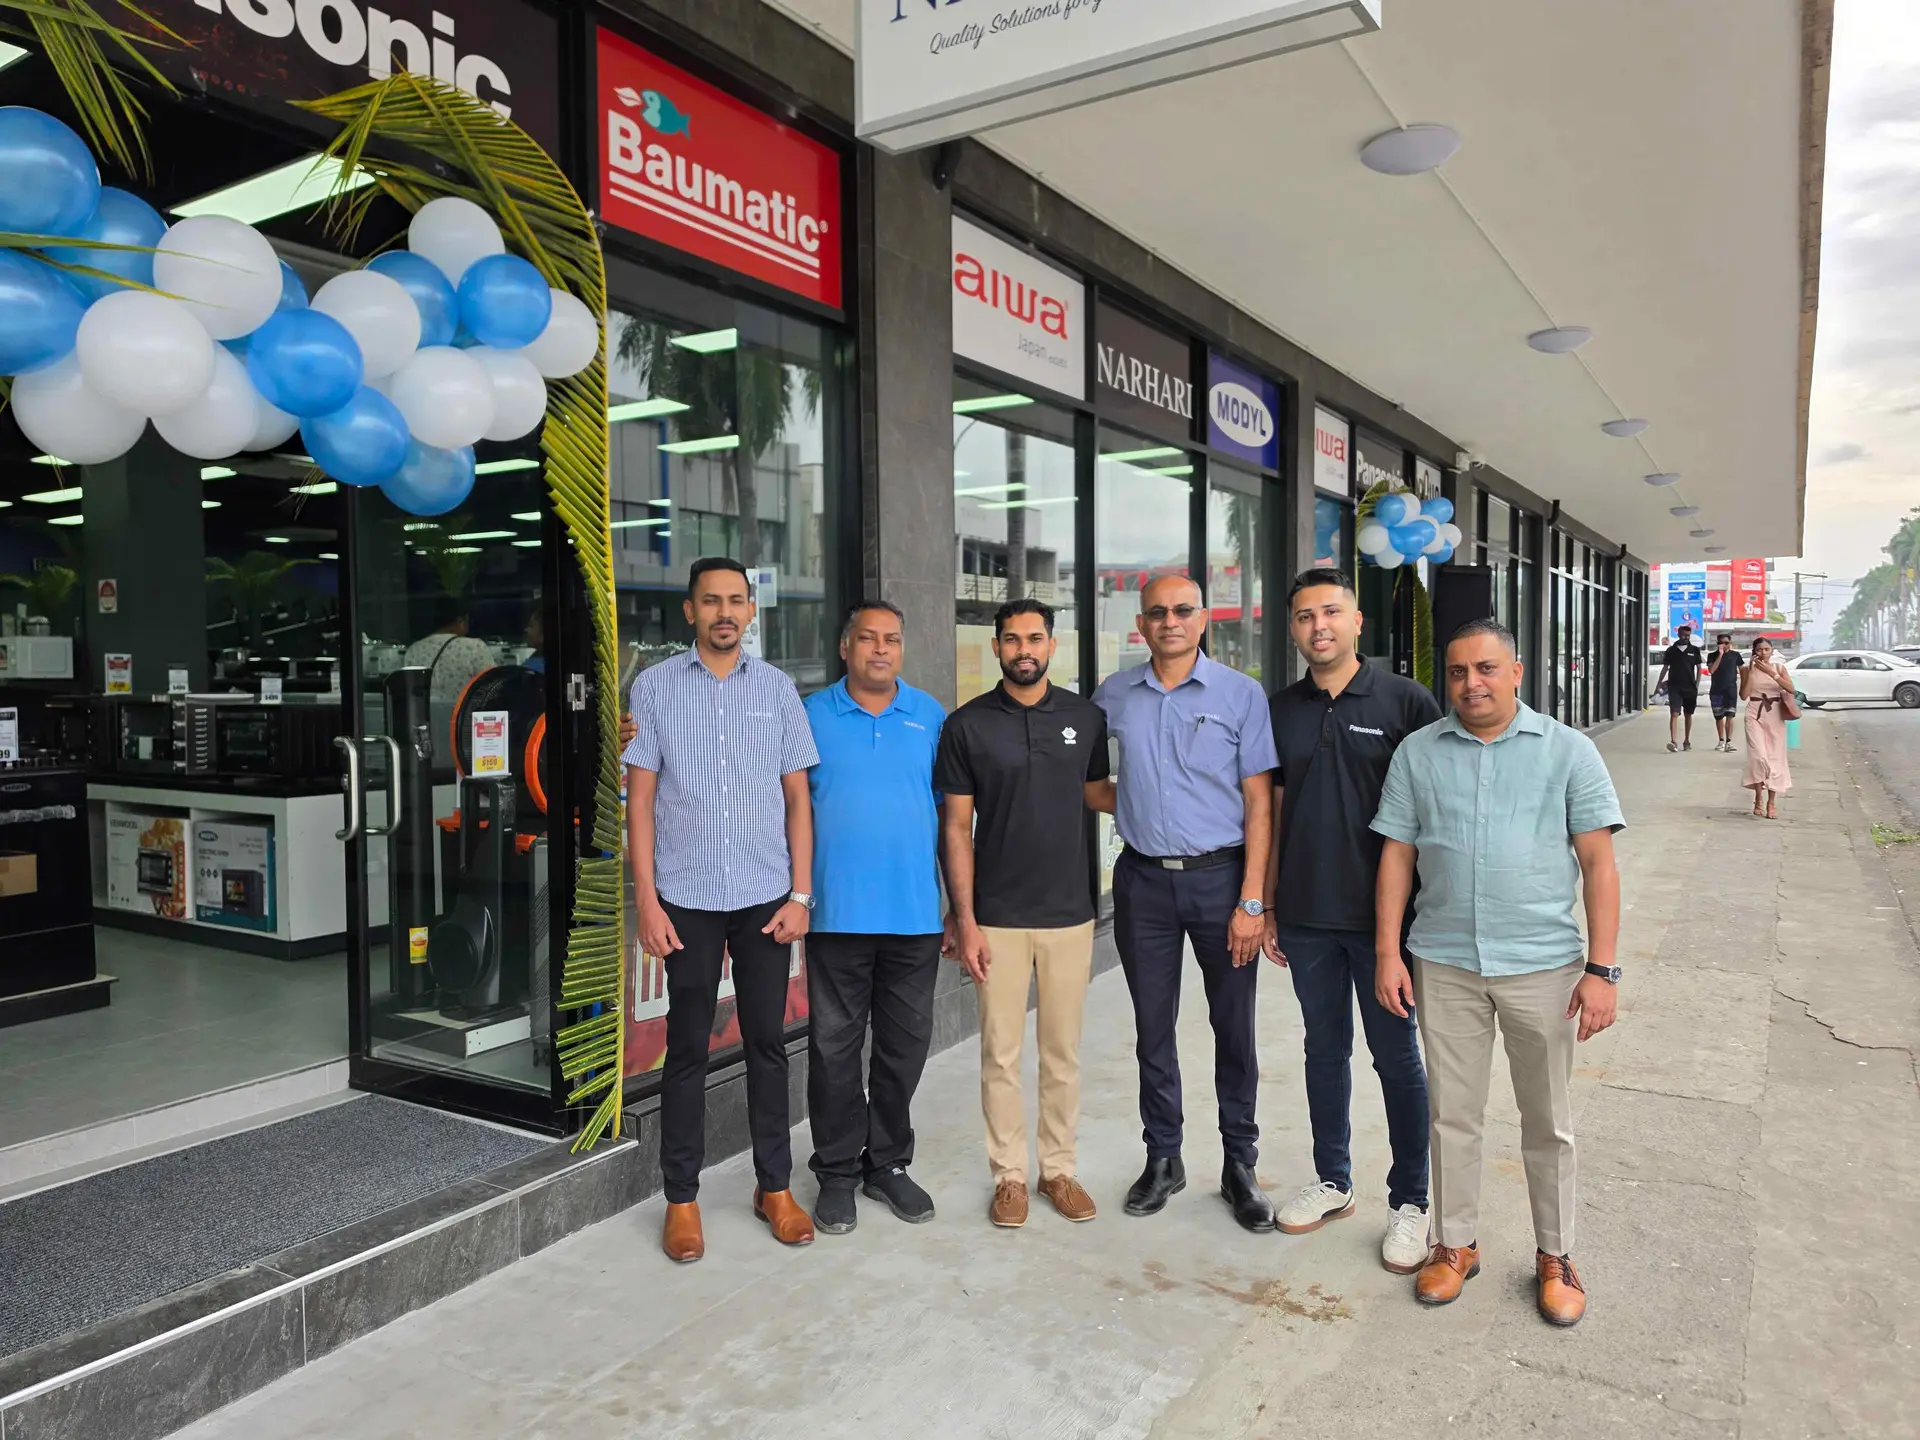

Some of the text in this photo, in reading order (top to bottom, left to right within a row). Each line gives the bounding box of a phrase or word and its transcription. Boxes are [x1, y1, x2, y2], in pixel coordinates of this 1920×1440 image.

[930, 25, 985, 54] Quality
[989, 0, 1061, 34] Solutions
[954, 253, 1068, 341] aiwa
[1097, 342, 1194, 420] NARHARI
[1217, 391, 1267, 437] MODYL
[1348, 724, 1384, 736] Panasonic
